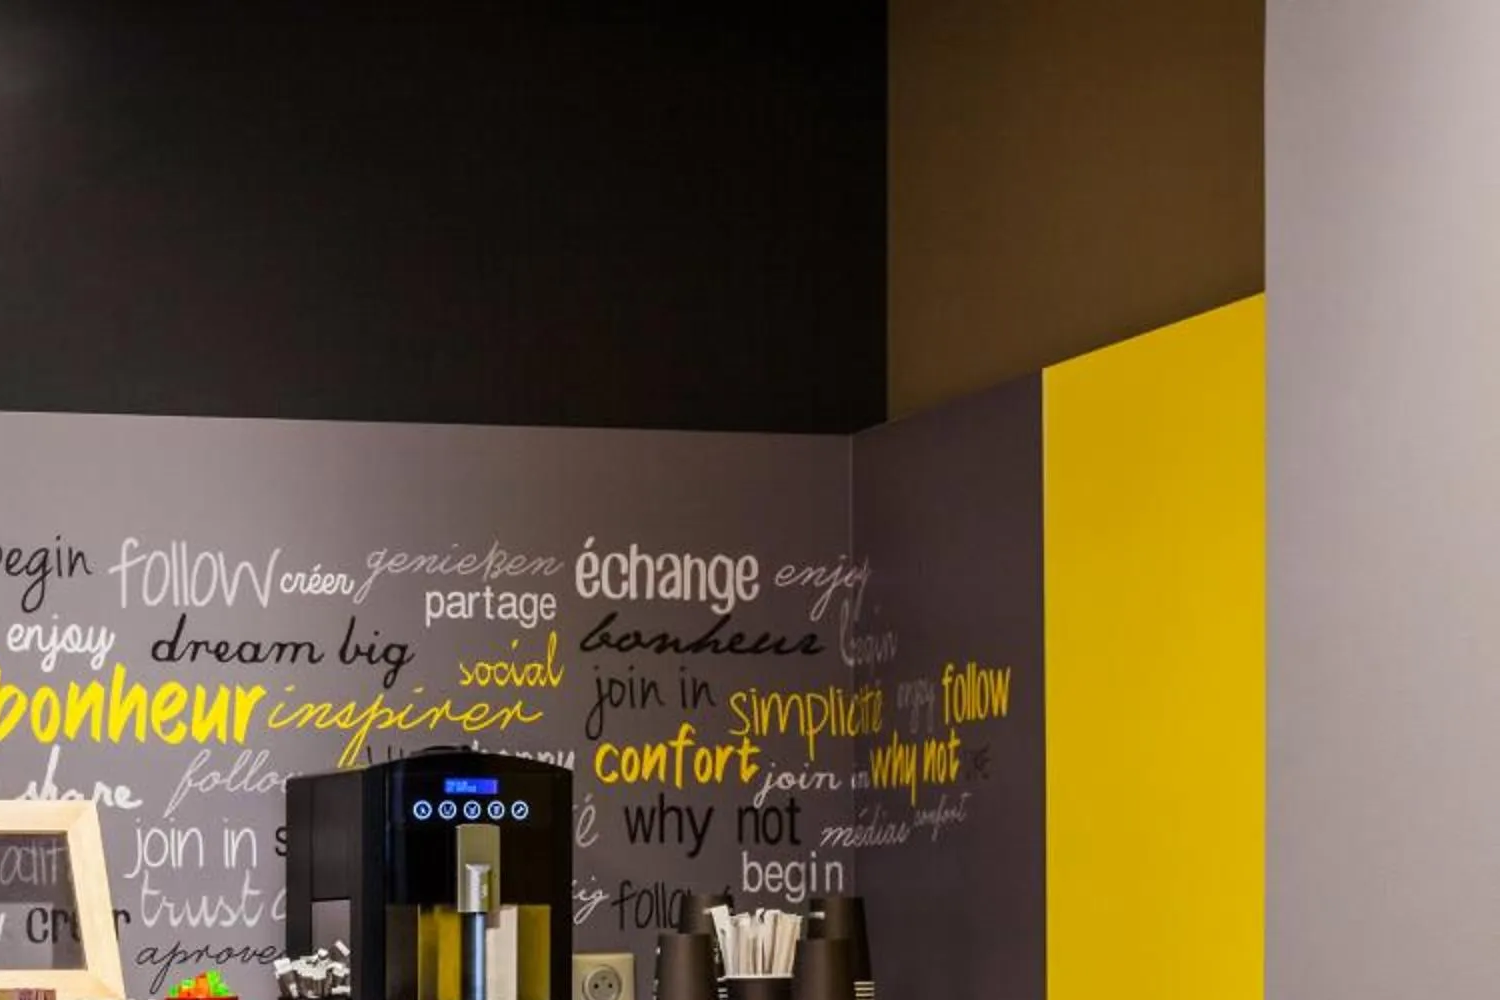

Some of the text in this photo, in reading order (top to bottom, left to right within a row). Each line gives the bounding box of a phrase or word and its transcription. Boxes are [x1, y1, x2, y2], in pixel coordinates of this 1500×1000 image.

[109, 537, 280, 608] follow
[280, 564, 354, 595] créer
[575, 536, 760, 614] échange
[425, 585, 557, 628] partage
[579, 611, 826, 656] bonheur
[7, 614, 115, 673] enjoy
[151, 612, 415, 689] dream big
[458, 631, 563, 687] social
[585, 665, 715, 740] join in
[728, 679, 883, 762] simplicité
[942, 662, 1011, 725] follow
[268, 685, 543, 769] inspirer
[594, 721, 763, 790] confort
[753, 762, 842, 809] join
[869, 731, 918, 807] why
[923, 728, 961, 784] not
[124, 816, 258, 879] join in
[624, 793, 715, 858] why
[736, 798, 802, 846] not
[140, 868, 264, 928] trust
[572, 876, 611, 925] ig
[611, 879, 692, 932] follo
[742, 850, 844, 902] begin
[26, 906, 131, 945] crr
[136, 940, 286, 995] aprove
